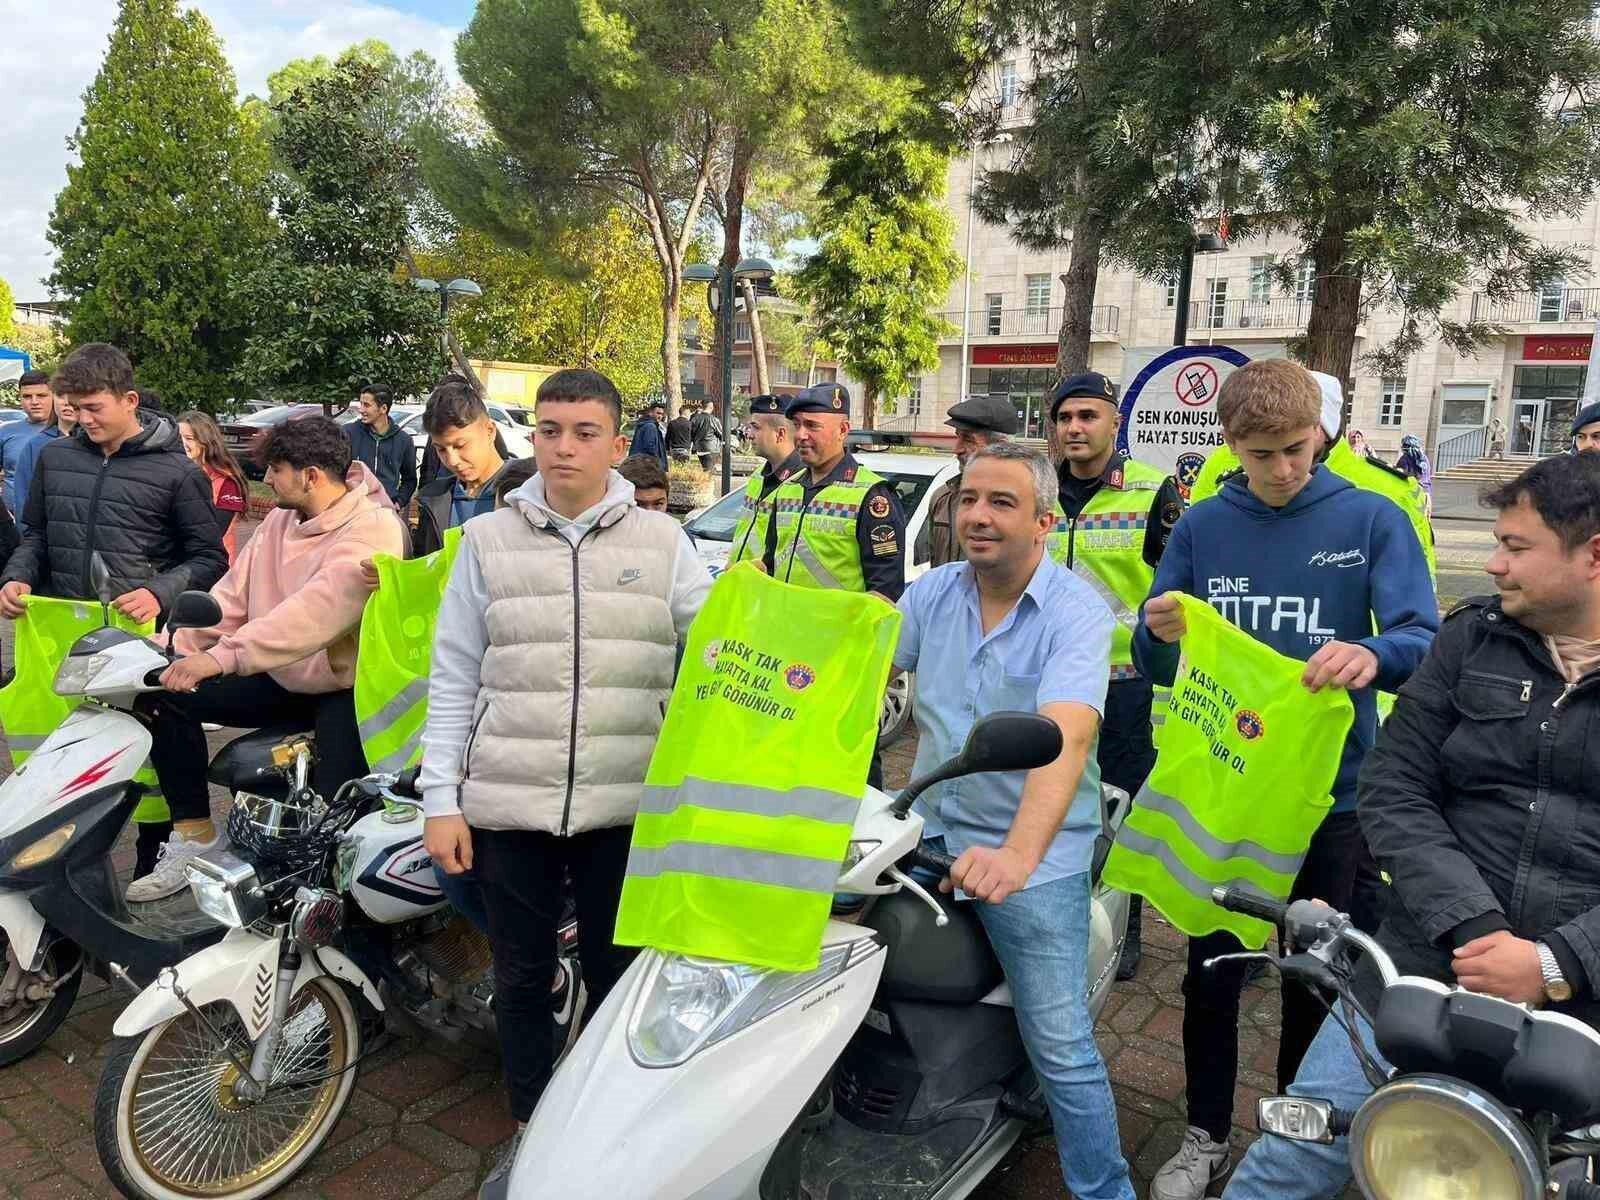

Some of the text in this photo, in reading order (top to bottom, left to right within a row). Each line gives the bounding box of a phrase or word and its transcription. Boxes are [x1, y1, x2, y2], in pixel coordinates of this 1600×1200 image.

[1137, 410, 1221, 428] SEN KONUŞU
[1137, 430, 1178, 444] HAYAT
[1208, 575, 1249, 597] ÇİNE
[721, 639, 782, 672] KASK TAK
[751, 674, 772, 692] KAL
[1189, 666, 1219, 697] KASK
[723, 684, 779, 717] GÖRÜNÜR
[781, 706, 797, 720] OL
[1182, 686, 1220, 721] HAYATTA
[1231, 755, 1245, 775] OL
